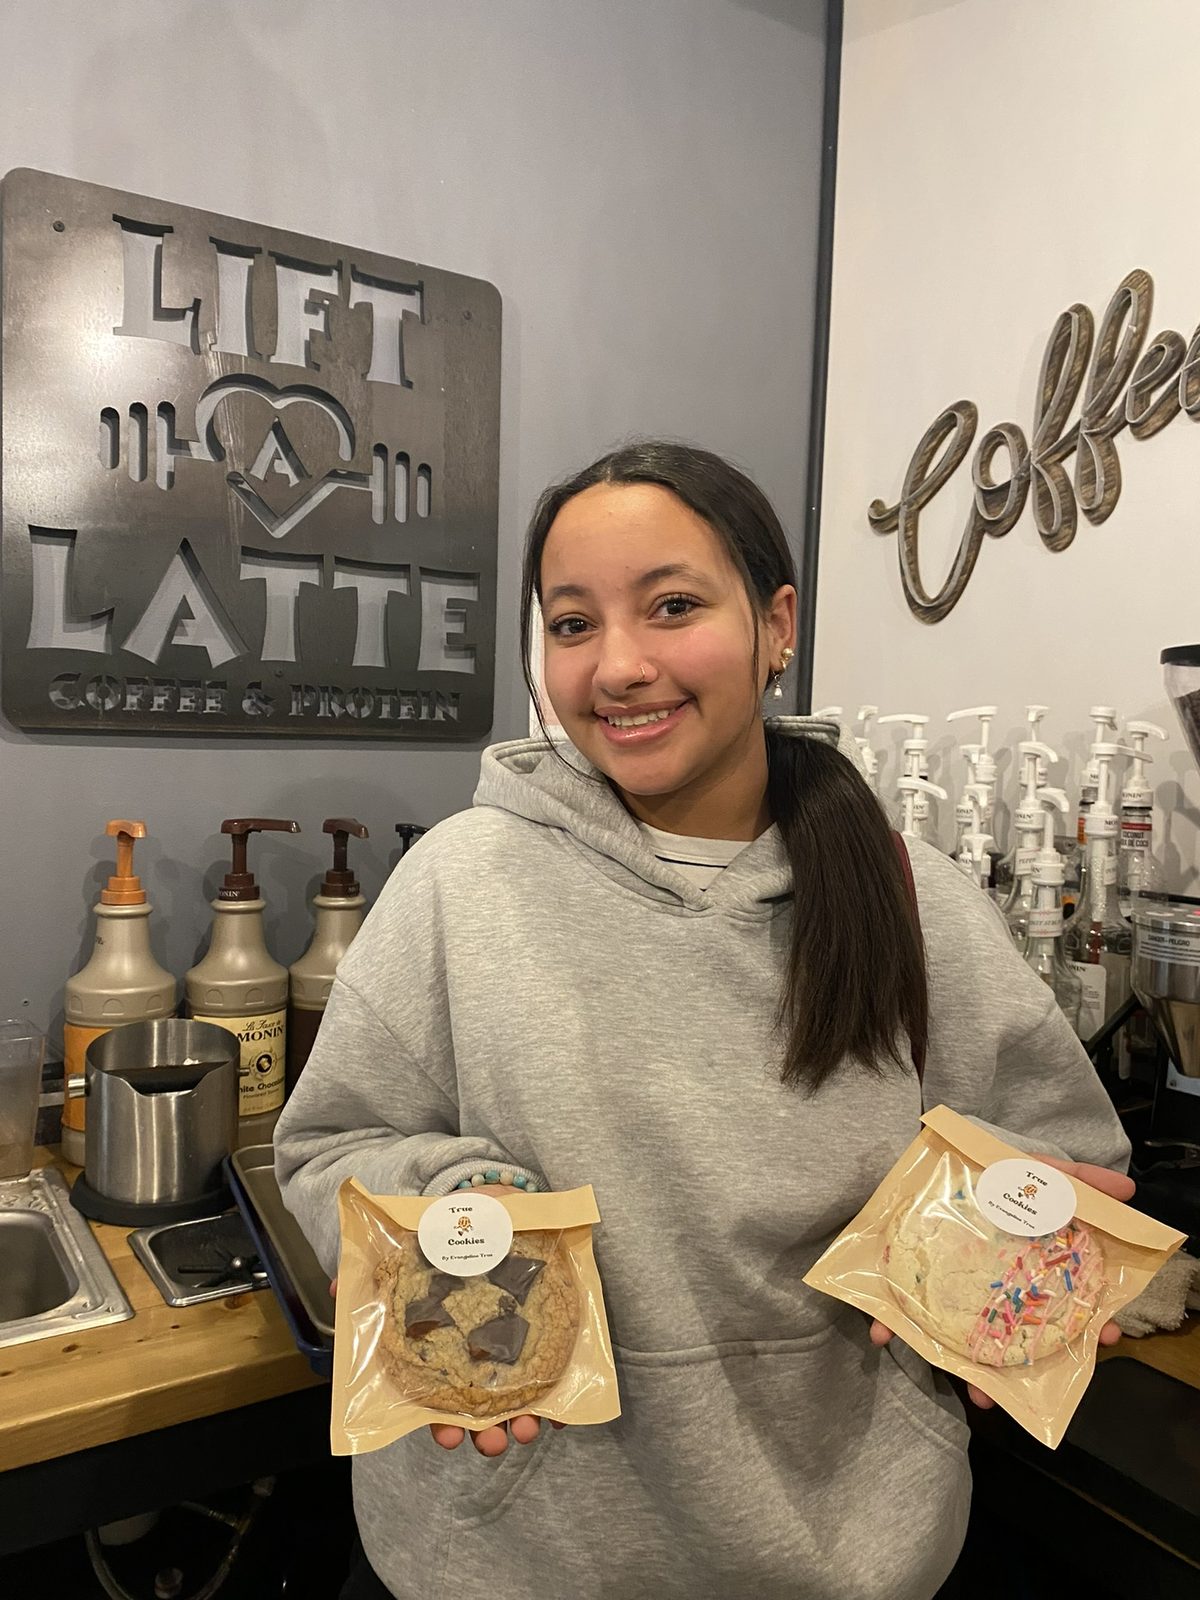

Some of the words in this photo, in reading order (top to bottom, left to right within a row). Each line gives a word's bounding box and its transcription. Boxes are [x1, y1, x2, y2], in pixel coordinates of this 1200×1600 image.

[112, 213, 425, 389] LIFT
[245, 416, 313, 488] A
[26, 524, 480, 674] LATTE
[49, 672, 228, 716] COFFEE
[241, 680, 277, 717] &
[288, 684, 463, 723] PROTEIN
[237, 1025, 284, 1043] MONIN
[1026, 1171, 1048, 1186] True
[448, 1206, 473, 1214] True
[1003, 1192, 1038, 1215] Cookies
[1023, 1220, 1035, 1229] True
[447, 1237, 485, 1246] Cookies
